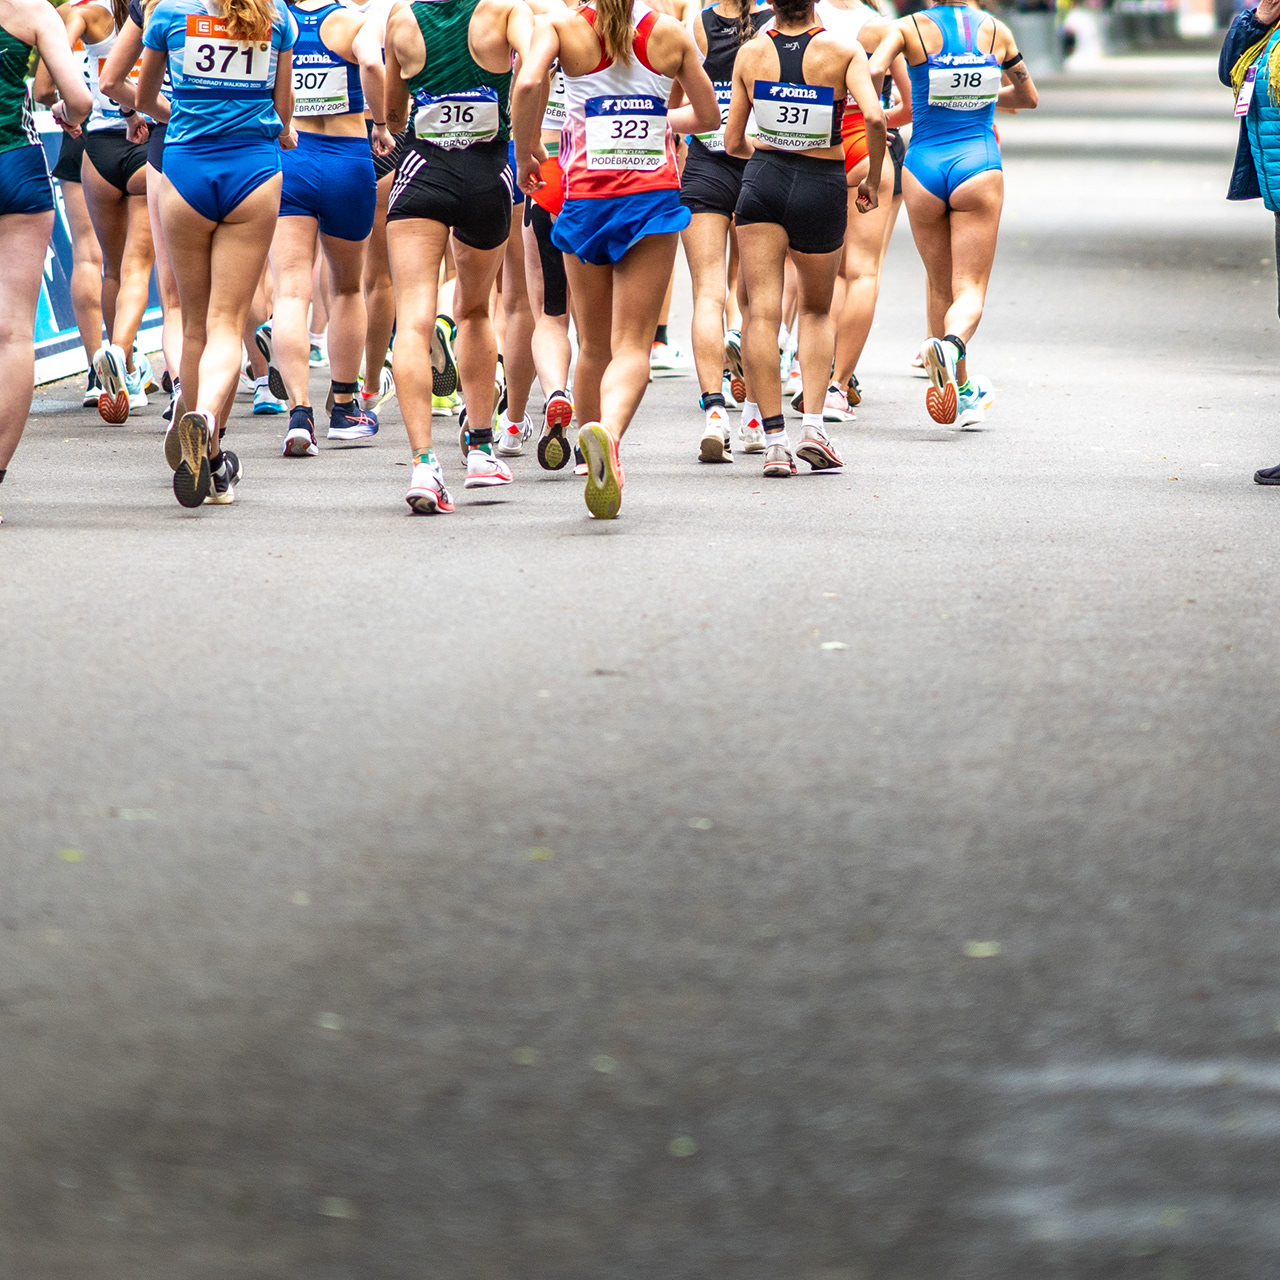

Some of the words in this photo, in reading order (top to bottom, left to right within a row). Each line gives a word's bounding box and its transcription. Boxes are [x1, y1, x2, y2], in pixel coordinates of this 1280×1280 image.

[195, 43, 254, 75] 371
[223, 81, 249, 89] WALKING
[294, 72, 328, 90] 307
[950, 72, 982, 88] 318
[440, 105, 475, 124] 316
[776, 105, 809, 125] 331
[611, 119, 649, 140] 323
[807, 138, 827, 147] 2025
[646, 157, 660, 166] 202
